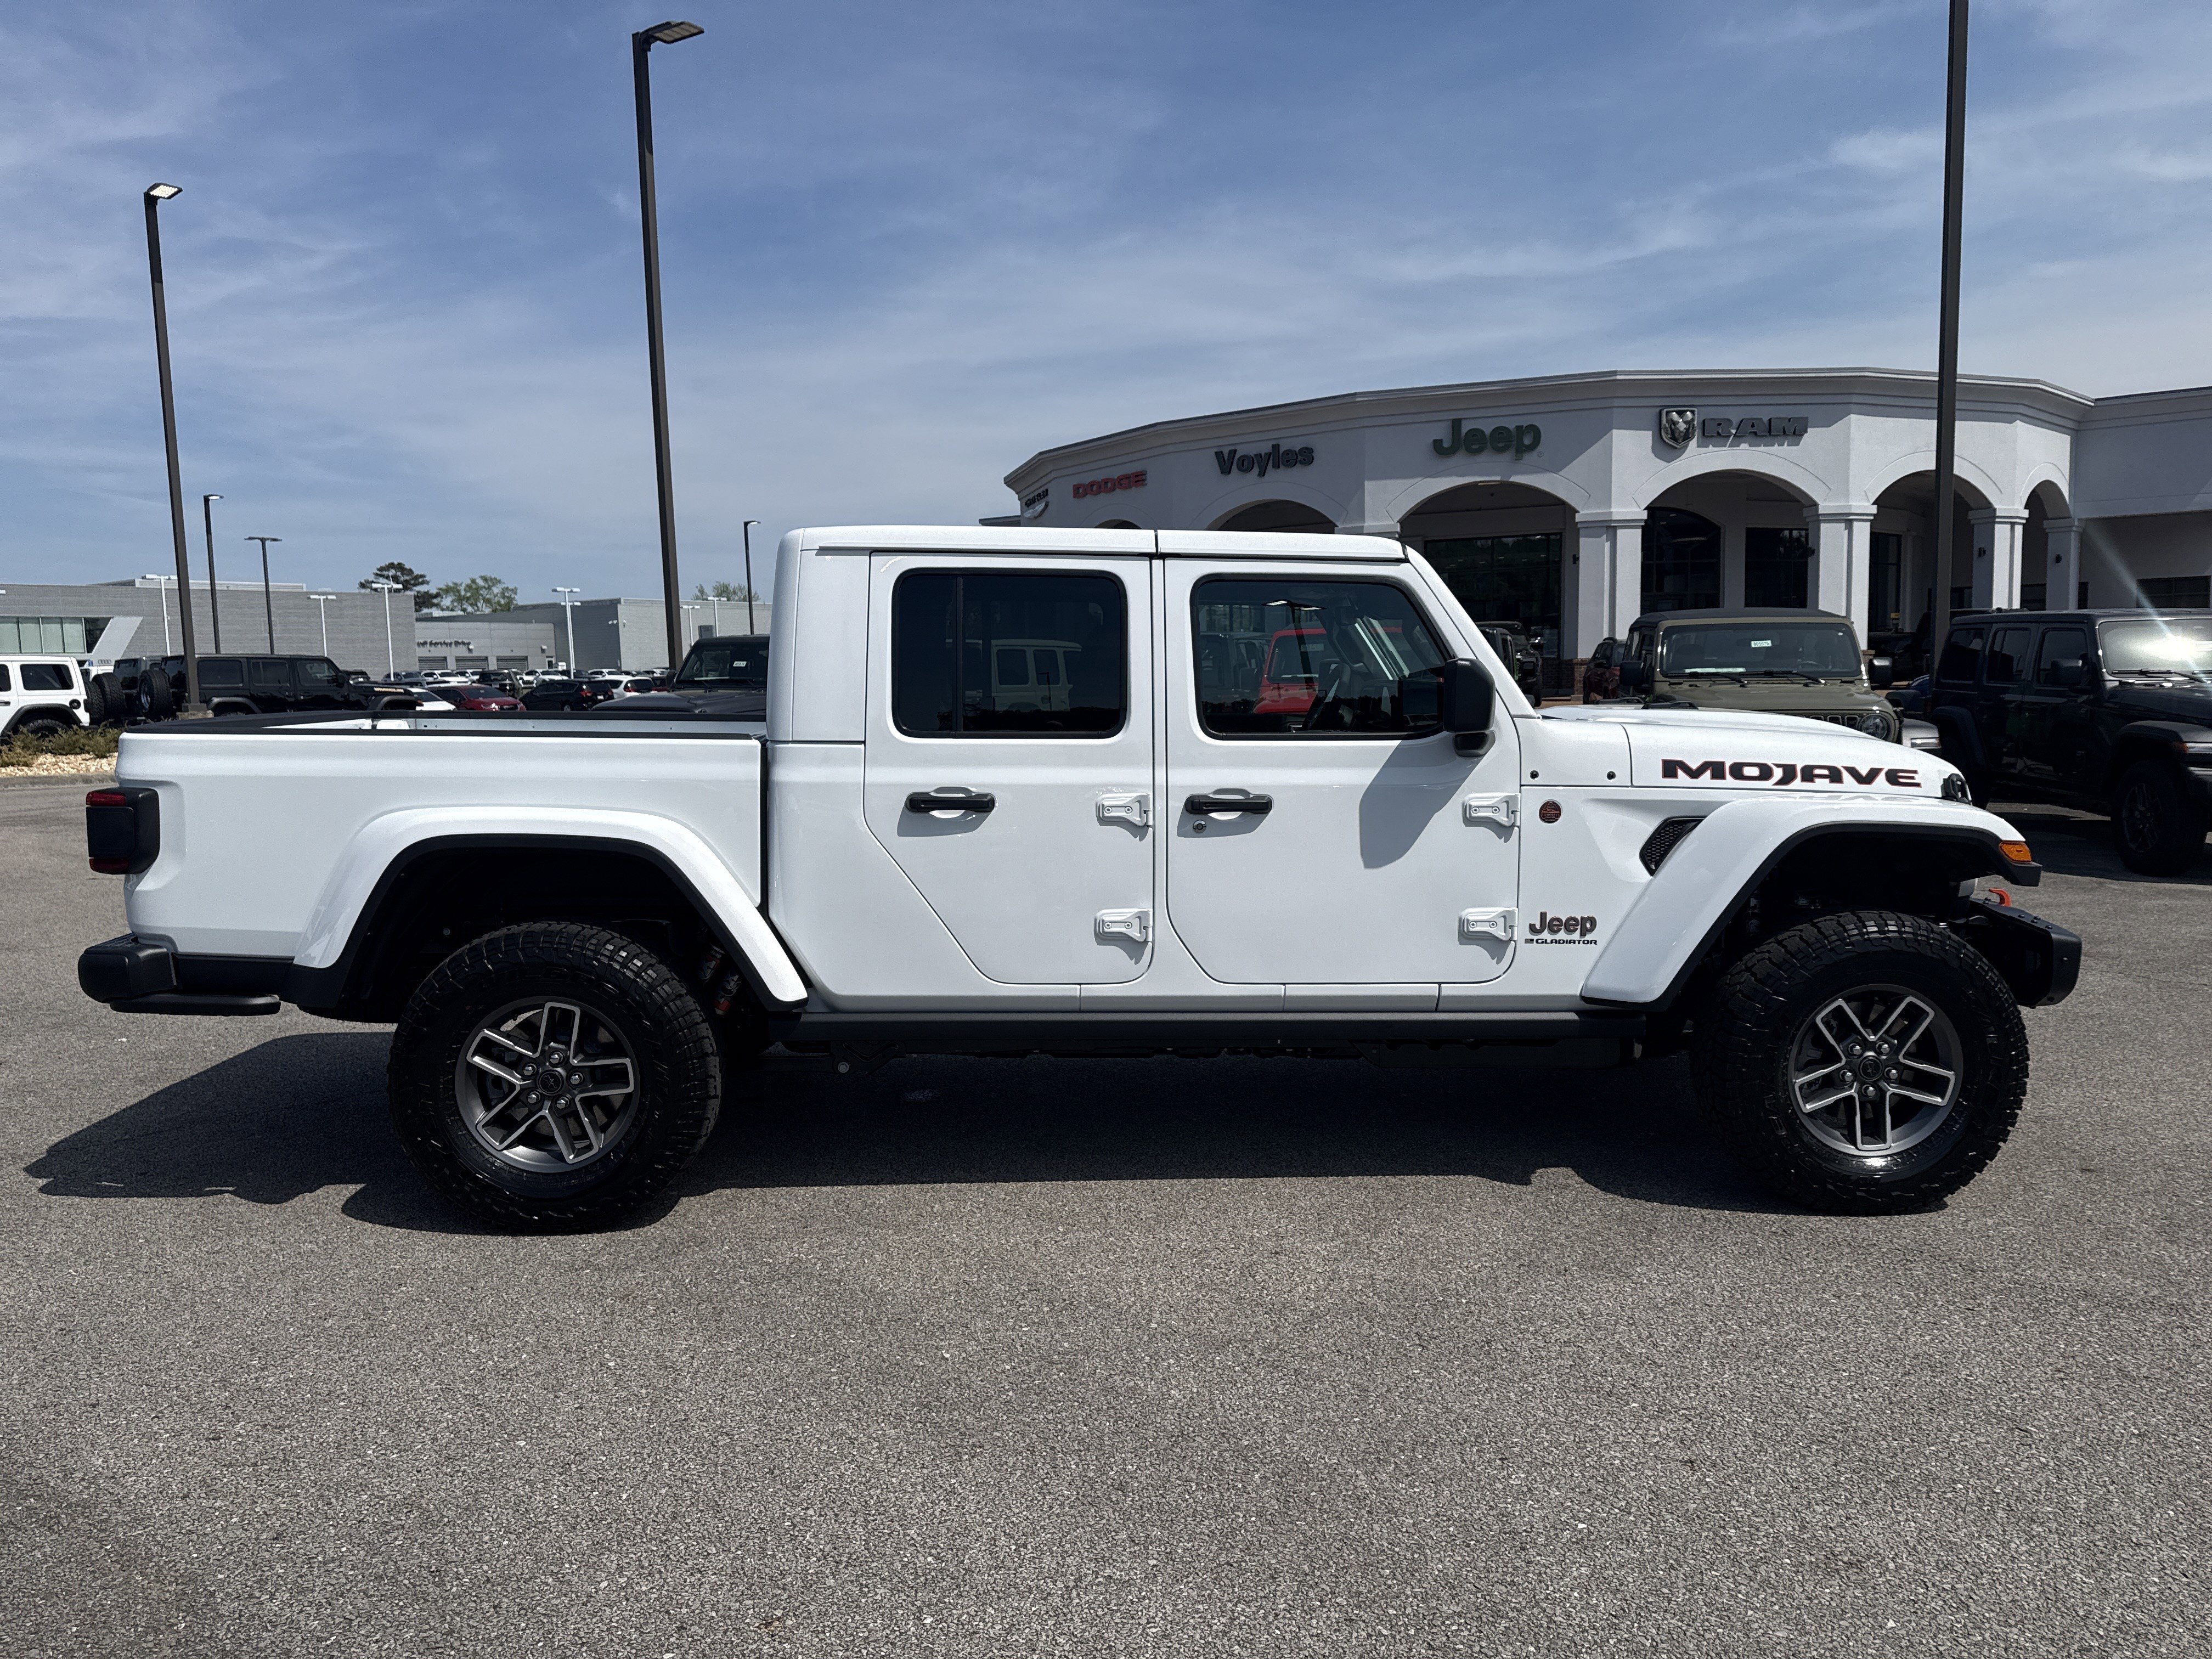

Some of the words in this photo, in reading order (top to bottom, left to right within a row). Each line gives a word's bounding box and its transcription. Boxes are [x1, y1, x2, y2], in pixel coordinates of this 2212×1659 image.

[1433, 419, 1542, 460] Jeep
[1703, 417, 1808, 437] RAM
[1214, 443, 1314, 477] Voyles
[1073, 470, 1148, 499] DODGE
[1661, 759, 1922, 788] MOJAVE
[1528, 911, 1597, 936] Jeep
